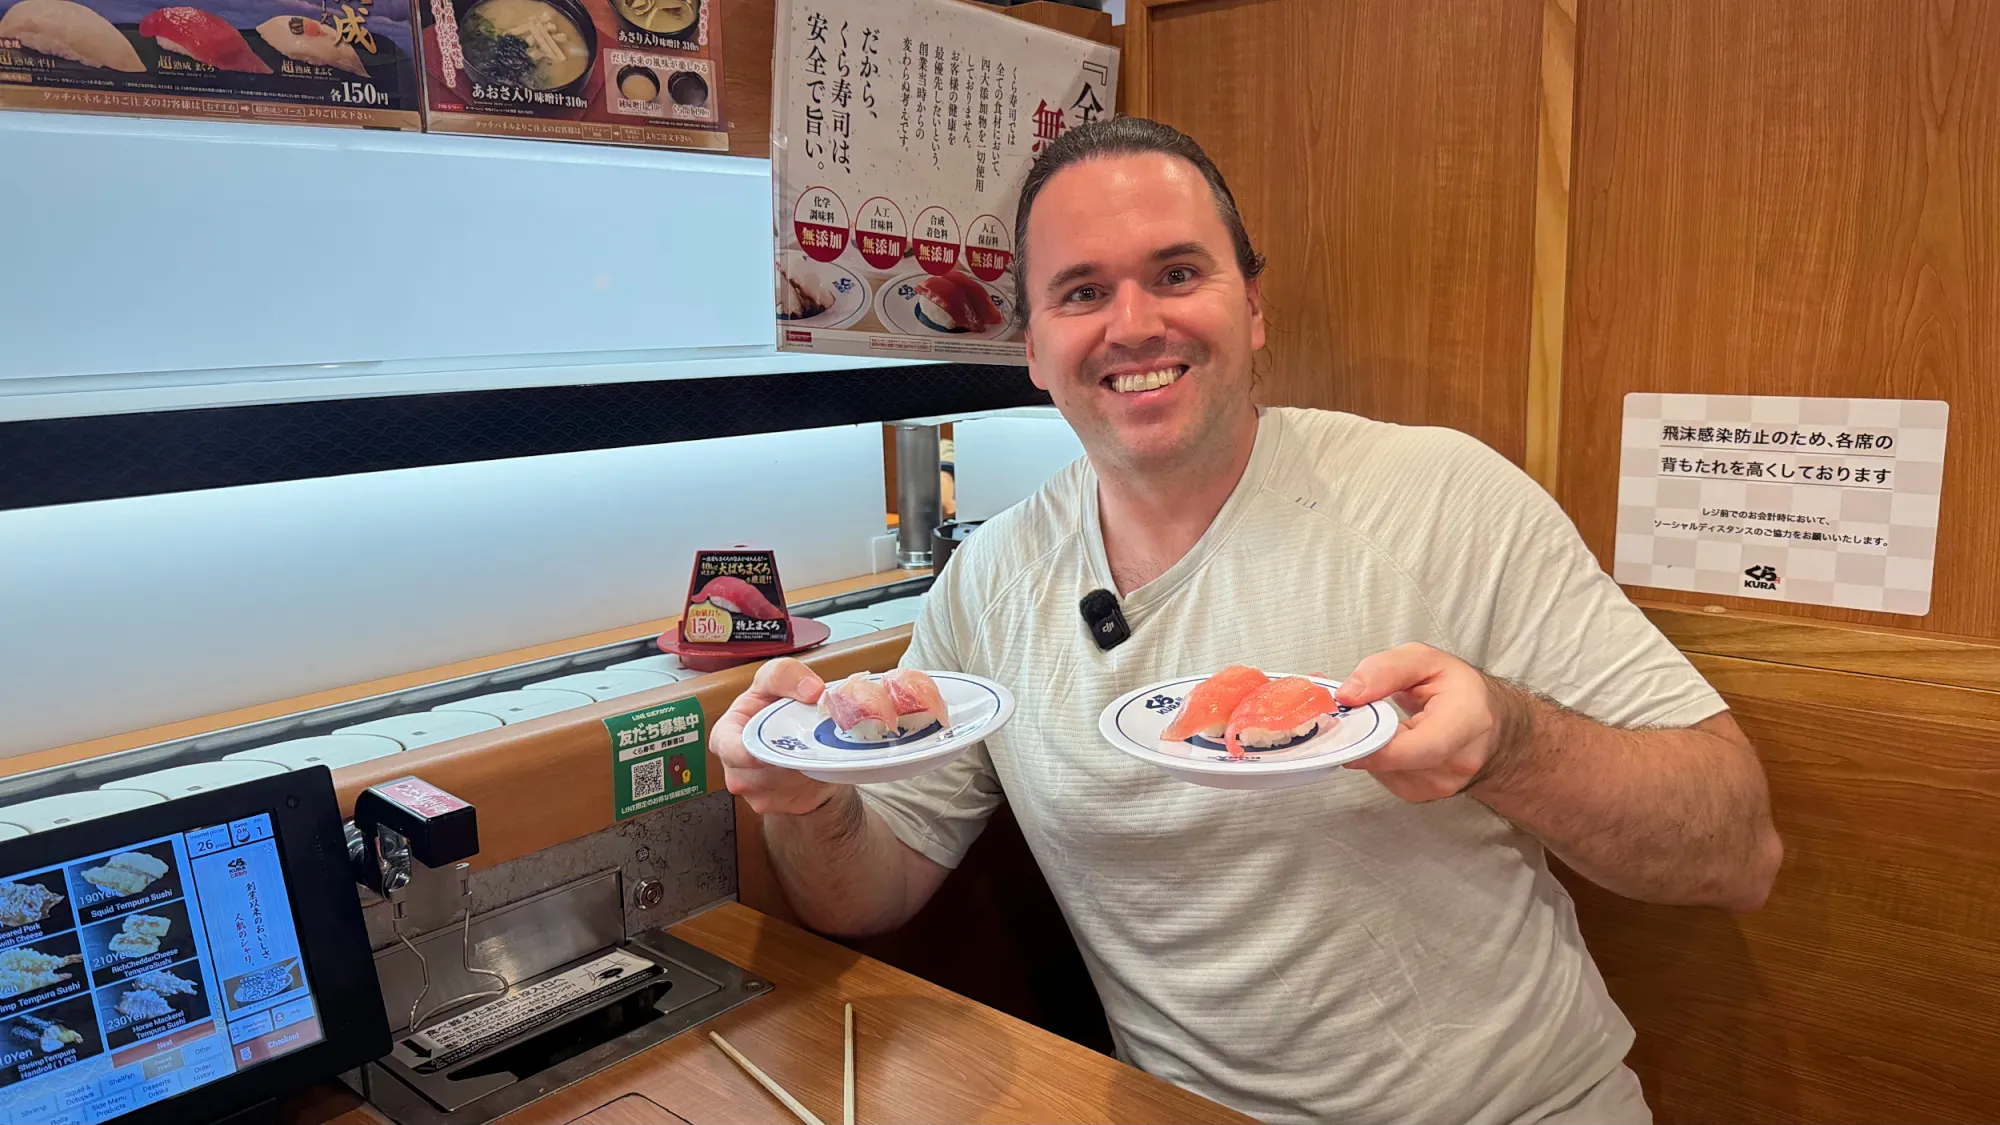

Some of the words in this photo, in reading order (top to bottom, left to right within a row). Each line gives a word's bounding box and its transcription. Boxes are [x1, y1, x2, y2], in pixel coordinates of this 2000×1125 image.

[860, 27, 880, 119] だから、
[330, 82, 389, 106] 各150円
[805, 12, 829, 171] 安全で旨い。
[832, 20, 852, 175] くら寿司は、
[899, 36, 912, 151] 変わらぬ考えです。
[916, 41, 929, 140] 創業当時からの
[948, 51, 960, 146] お客様の健康を
[932, 45, 944, 171] 最優先したいという、
[963, 54, 975, 149] しておりません。
[1007, 67, 1018, 146] くら寿司では
[975, 56, 991, 192] 四大添加物を一切使用
[992, 62, 1005, 177] 全ての食材において、
[814, 195, 831, 208] 化学
[809, 209, 835, 223] 調味料
[874, 205, 890, 218] 人工
[870, 217, 893, 232] 甘味料
[930, 215, 945, 227] 合成
[982, 222, 996, 234] 人工
[802, 226, 843, 250] 無添加
[926, 227, 948, 241] 着色料
[978, 233, 998, 247] 保存料
[862, 235, 900, 257] 無添加
[918, 243, 954, 264] 無添加
[971, 250, 1004, 270] 無添加
[1662, 424, 1894, 450] 飛沫感染防止のため、各席の
[1661, 456, 1892, 484] 背もたれを高くしております
[1702, 507, 1831, 526] レジ前でのお会計時において、
[1653, 520, 1890, 547] ソーシャルディスタンスのご協力をお願いいたします。
[1744, 564, 1778, 581] くら
[1744, 580, 1777, 590] KURA
[691, 617, 725, 635] 150円
[735, 620, 781, 631] 特上まぐろ
[632, 713, 646, 721] LINE
[617, 713, 700, 748] 友だち募集中
[632, 744, 655, 757] くら寿司
[257, 826, 263, 836] 1
[198, 840, 213, 852] 26
[229, 866, 246, 874] KURA
[79, 889, 118, 906] 190Yen
[91, 906, 114, 919] Squid
[116, 897, 150, 913] Tempura
[151, 889, 173, 901] Sushi
[24, 923, 41, 934] Pork
[17, 931, 43, 944] Cheese
[93, 950, 132, 968] 210Yen
[112, 949, 178, 974] RichCheddarCheese
[18, 992, 56, 1008] Tempura
[57, 981, 81, 994] Sushi
[107, 1012, 146, 1030] 230Yen
[132, 1022, 153, 1033] Horse
[154, 1010, 184, 1026] Mackerel
[136, 1024, 167, 1041] Tempura
[168, 1018, 186, 1029] Sushi
[157, 1039, 172, 1049] Next
[268, 1032, 299, 1049] Checkout
[195, 1044, 212, 1055] Other
[194, 1063, 211, 1073] Order
[109, 1072, 135, 1087] Shellfish
[143, 1078, 171, 1093] Desserts
[65, 1087, 85, 1098] Squid
[66, 1092, 95, 1106] Octopus
[148, 1087, 169, 1098] Drinks
[21, 1104, 47, 1118] Shrimp
[92, 1103, 108, 1111] Side
[109, 1096, 127, 1107] Menu
[96, 1103, 126, 1118] Products
